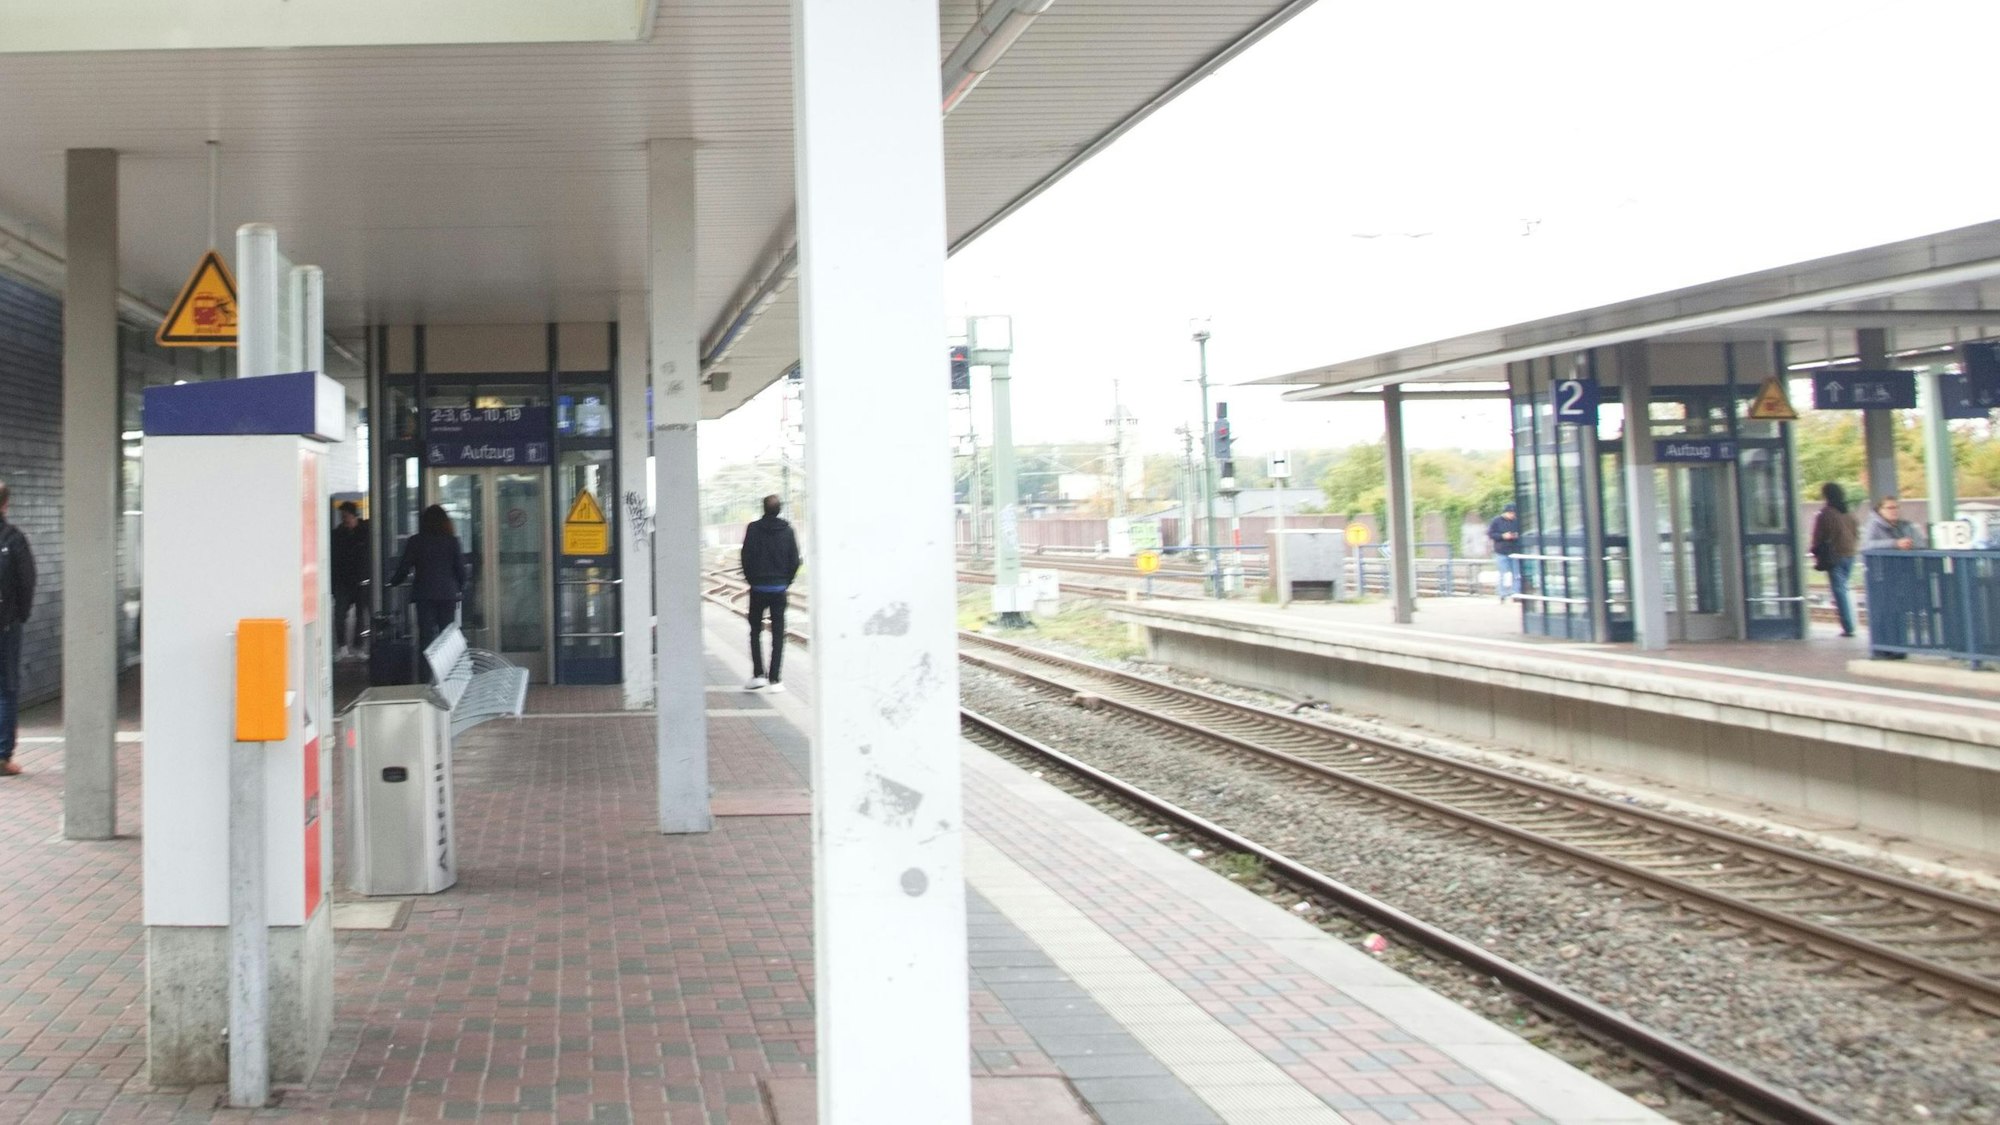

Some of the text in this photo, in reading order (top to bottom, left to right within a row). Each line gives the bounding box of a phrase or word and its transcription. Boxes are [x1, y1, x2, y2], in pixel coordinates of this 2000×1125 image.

[1557, 380, 1584, 415] 2
[460, 445, 515, 462] Aufzug
[1664, 442, 1711, 459] Aufzug
